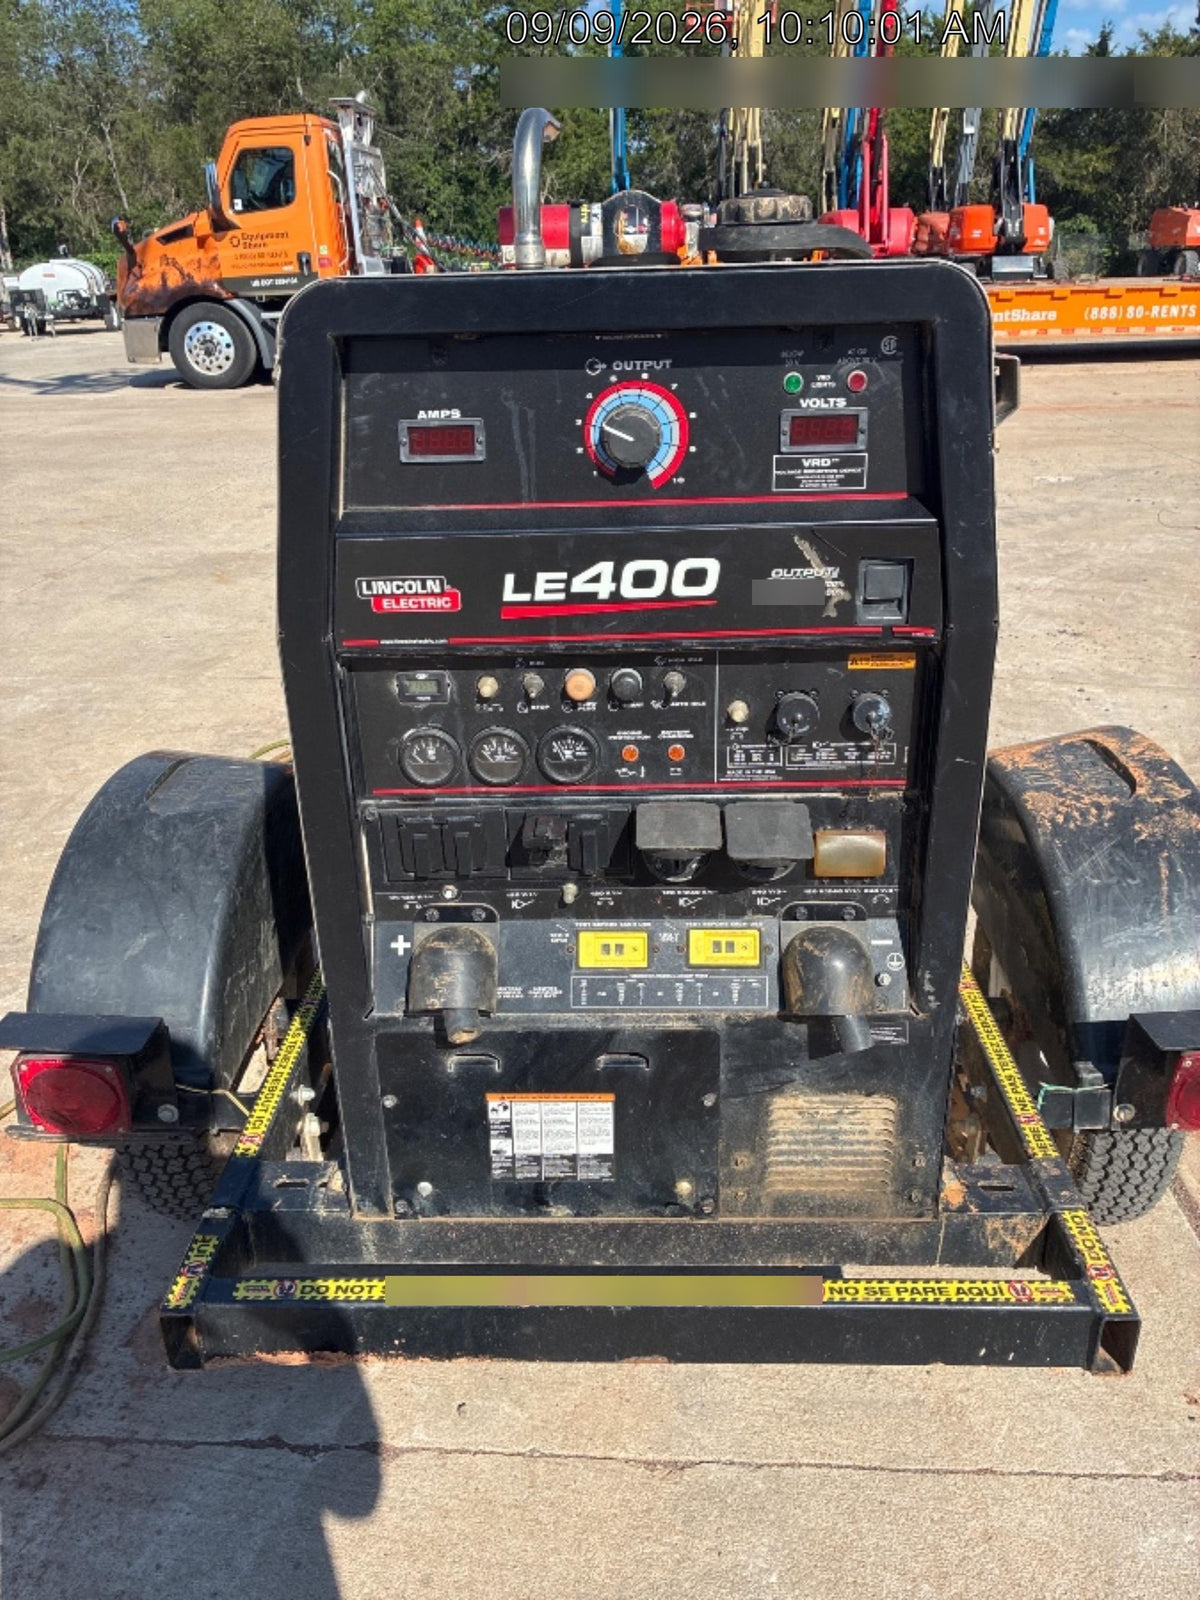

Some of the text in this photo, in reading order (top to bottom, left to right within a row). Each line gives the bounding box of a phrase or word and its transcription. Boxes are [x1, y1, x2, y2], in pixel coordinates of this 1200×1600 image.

[1126, 304, 1197, 320] 80-RENTS
[613, 360, 673, 371] OUTPUT
[800, 398, 847, 408] VOLTS
[418, 408, 461, 419] AMPS
[503, 558, 721, 602] LE400
[362, 578, 442, 596] LINCOLN
[382, 596, 453, 610] ELECTRIC
[300, 1285, 330, 1295] DO
[334, 1285, 377, 1295] NOT
[829, 1286, 859, 1296] NO
[864, 1286, 891, 1296] SE
[896, 1286, 951, 1296] PARE
